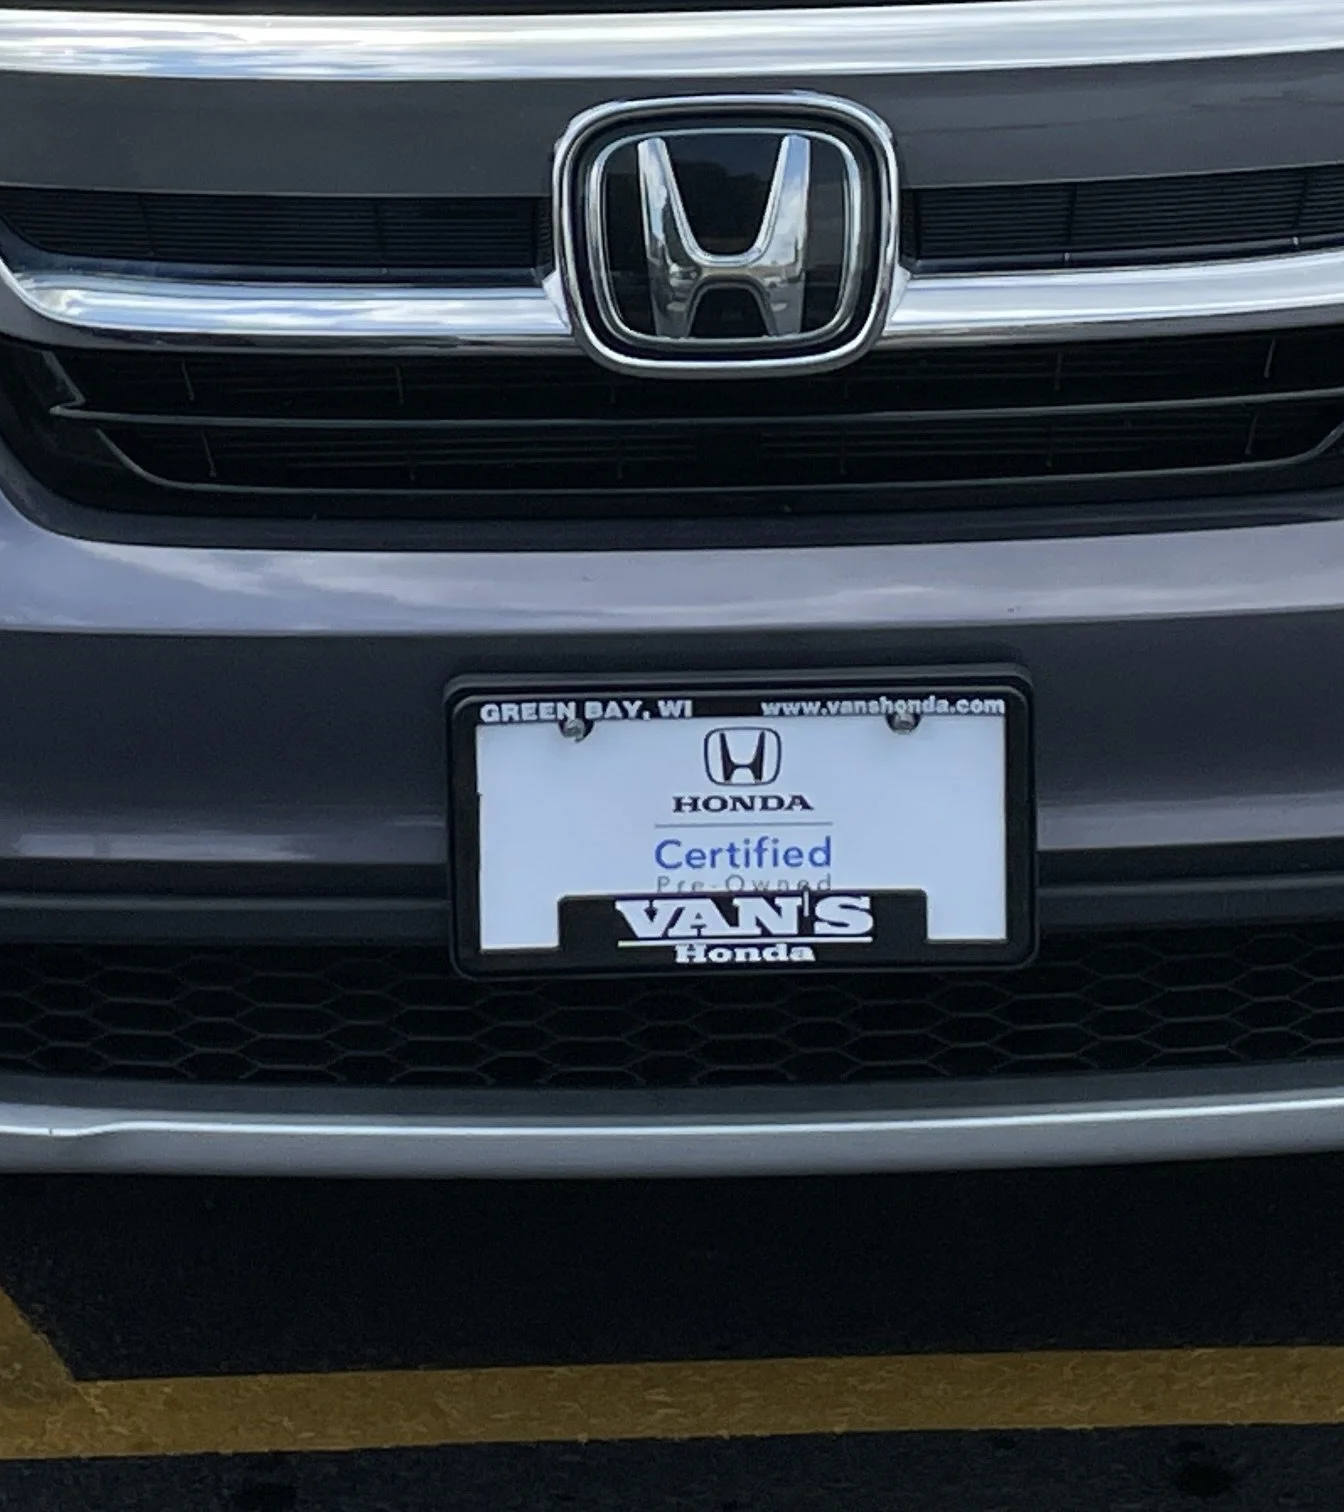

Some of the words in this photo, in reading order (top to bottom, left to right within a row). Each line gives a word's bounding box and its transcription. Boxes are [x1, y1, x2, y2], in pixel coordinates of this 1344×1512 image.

[479, 701, 576, 723] GREEN
[584, 700, 650, 721] BAY,
[658, 699, 693, 719] WI
[761, 695, 1005, 716] www.vanshonda.com
[672, 794, 814, 813] HONDA
[654, 835, 832, 869] Certified
[614, 890, 874, 938] VAN'S
[673, 943, 816, 964] Honda
